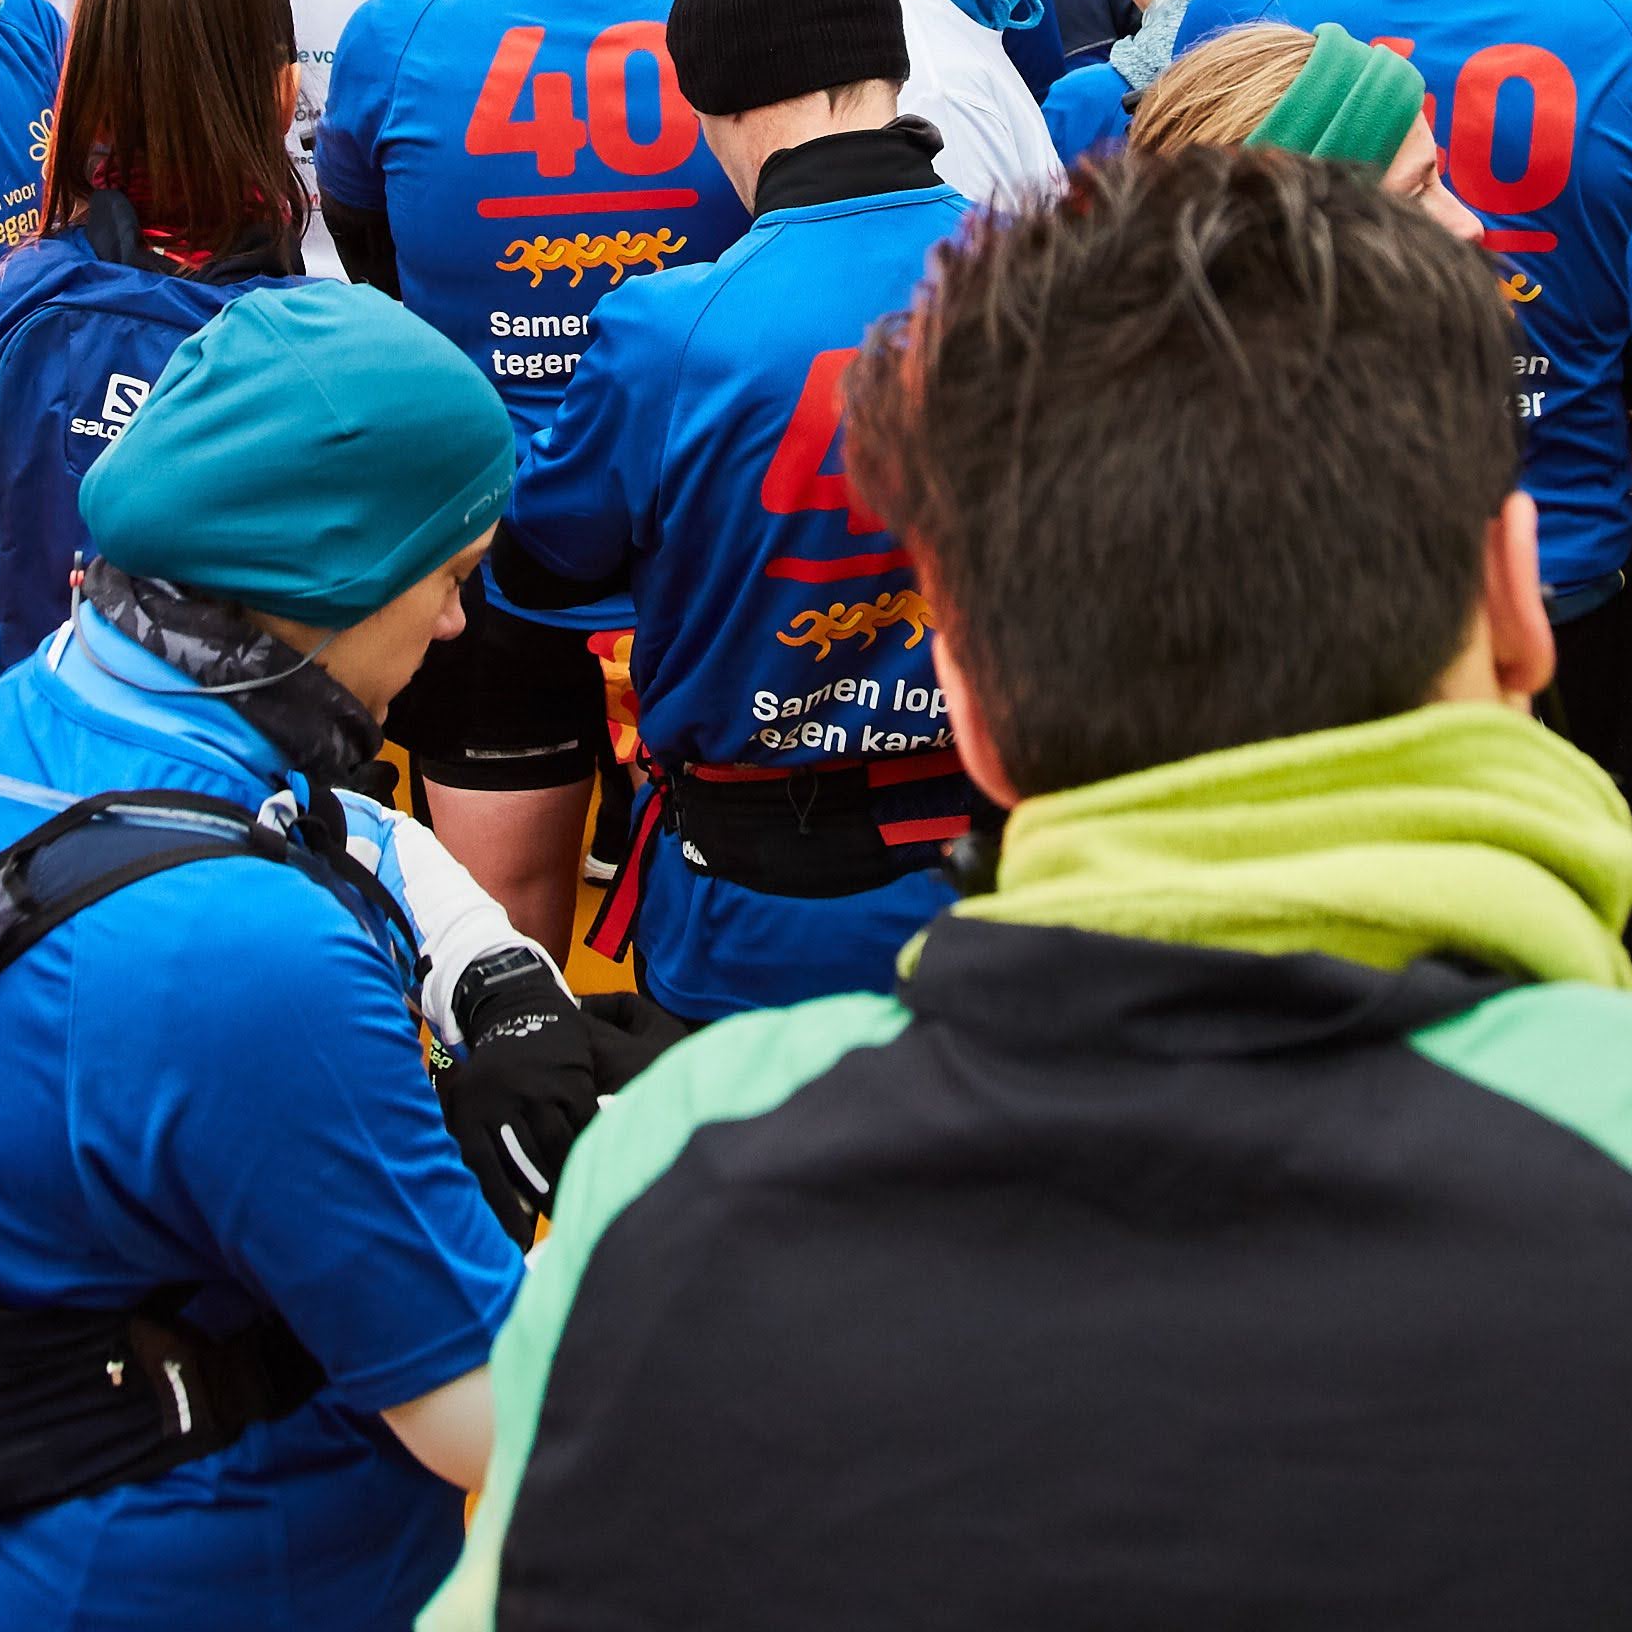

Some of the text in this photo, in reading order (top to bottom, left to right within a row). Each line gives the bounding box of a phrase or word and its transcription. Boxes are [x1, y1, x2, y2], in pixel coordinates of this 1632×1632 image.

[465, 20, 700, 179] 40
[3, 182, 36, 207] voor
[751, 677, 951, 722] Samen lop
